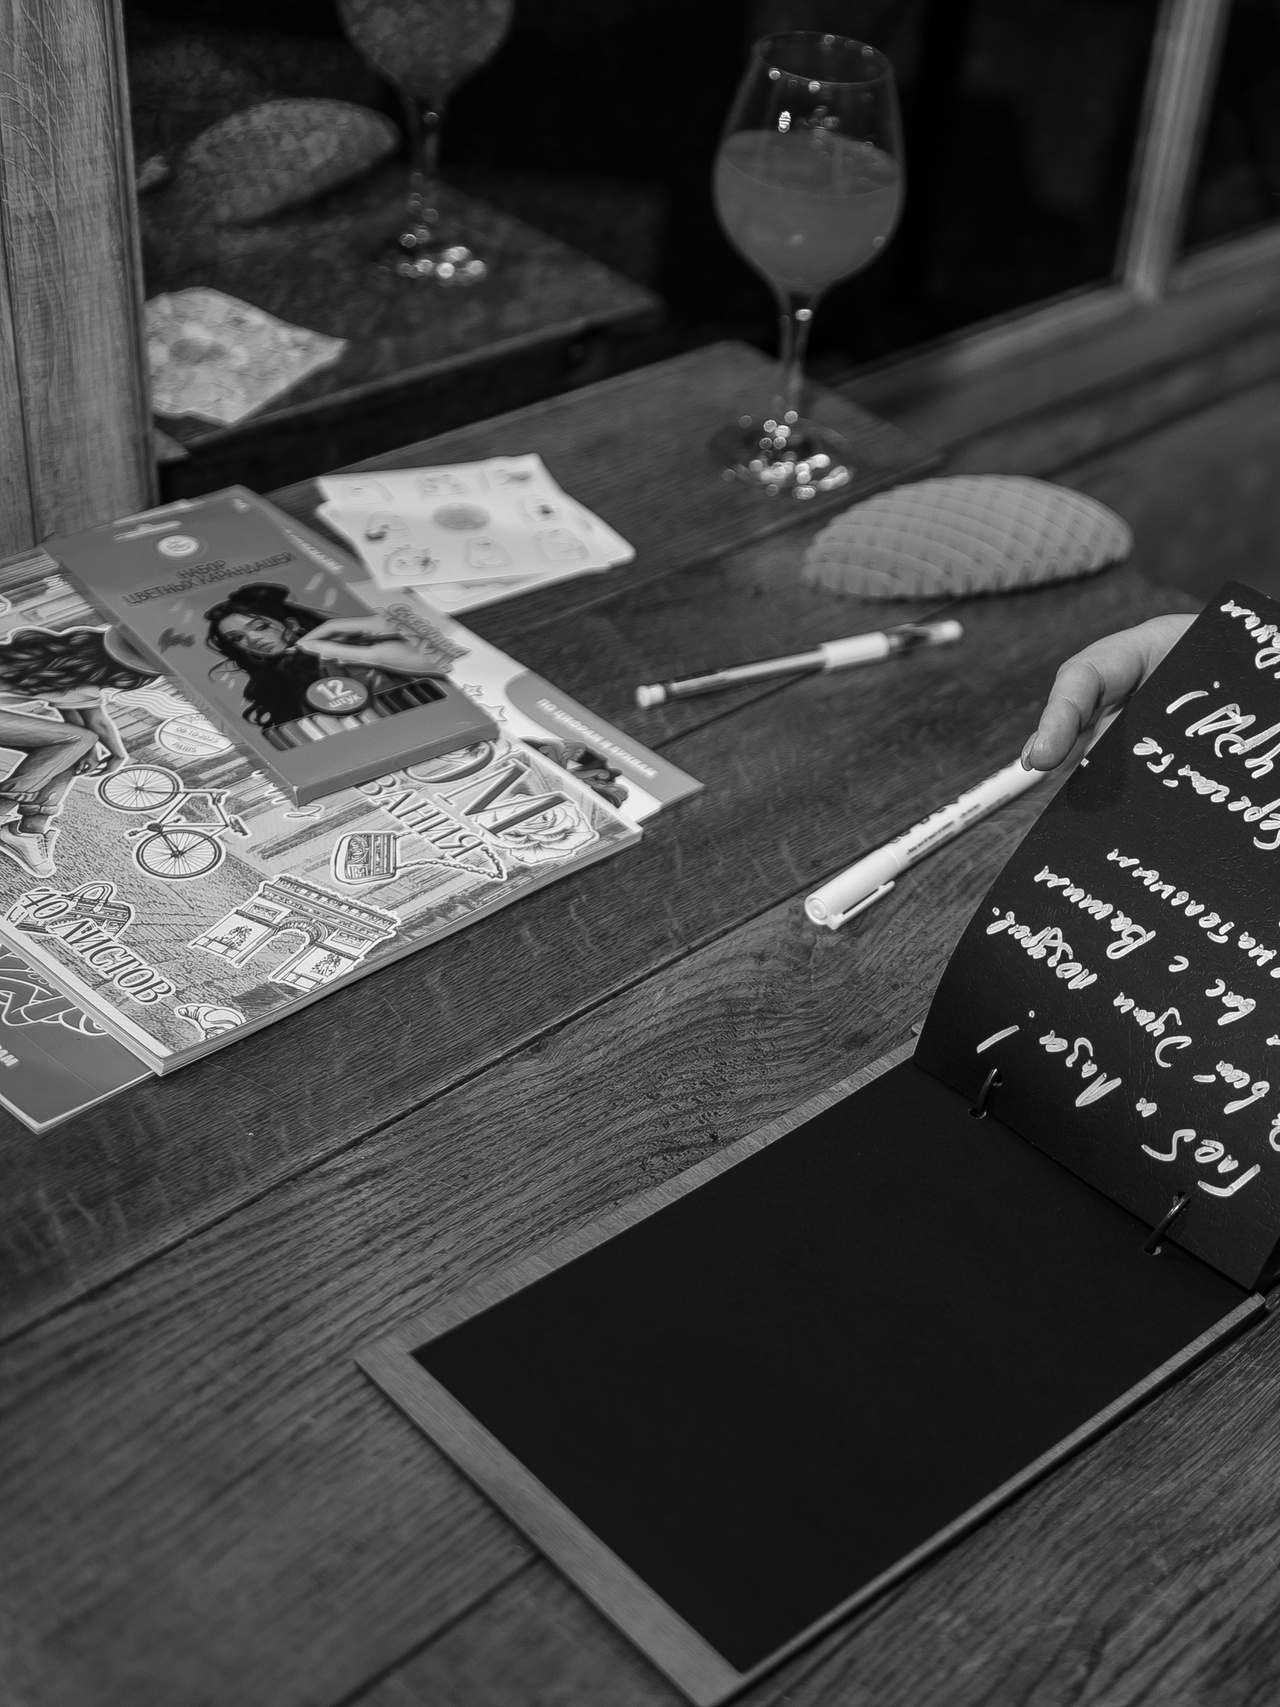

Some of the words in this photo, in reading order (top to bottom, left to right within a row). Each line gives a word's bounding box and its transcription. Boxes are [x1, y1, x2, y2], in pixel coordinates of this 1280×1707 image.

[122, 577, 199, 606] ЦВЕТНЫХ
[197, 551, 298, 585] КАРАНДАШЕЙ
[176, 560, 227, 580] НАБОР
[316, 679, 353, 701] 12
[171, 741, 198, 753] PARIS
[536, 697, 559, 712] ПО
[553, 708, 605, 743] ЦИФРАМ
[599, 738, 614, 749] И
[609, 745, 659, 778] БУКВАМ
[22, 892, 70, 920] 40
[1033, 864, 1157, 960] Вашим
[47, 919, 173, 1004] ЛИСТОВ
[1135, 1097, 1158, 1118] и
[1140, 1128, 1261, 1198] Глеб
